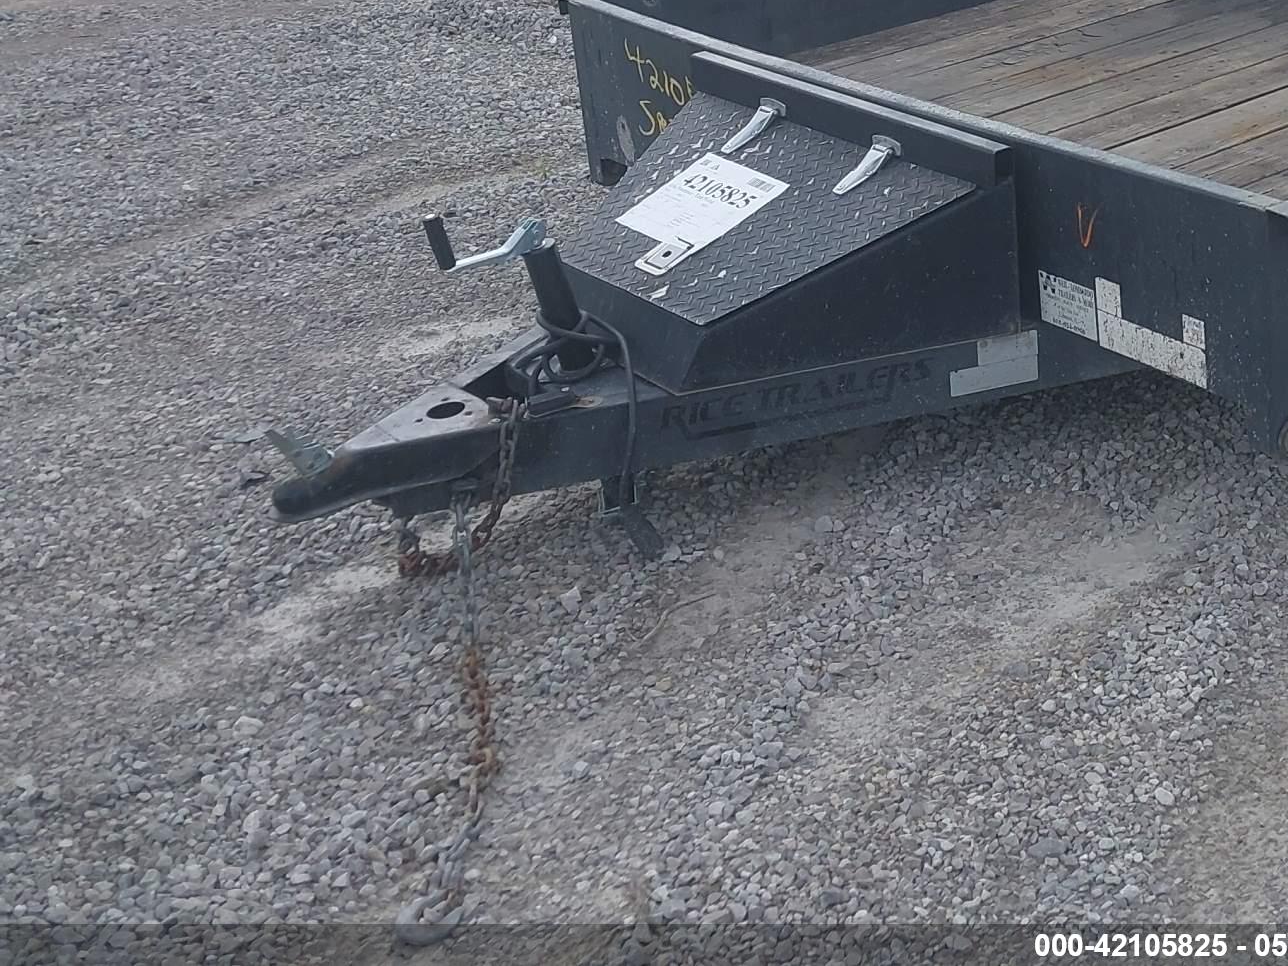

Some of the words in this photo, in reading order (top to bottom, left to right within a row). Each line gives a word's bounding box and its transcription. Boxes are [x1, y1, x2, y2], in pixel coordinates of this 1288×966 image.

[683, 173, 759, 209] 42105825
[659, 392, 748, 430] RICE
[755, 356, 936, 412] TRAILERS
